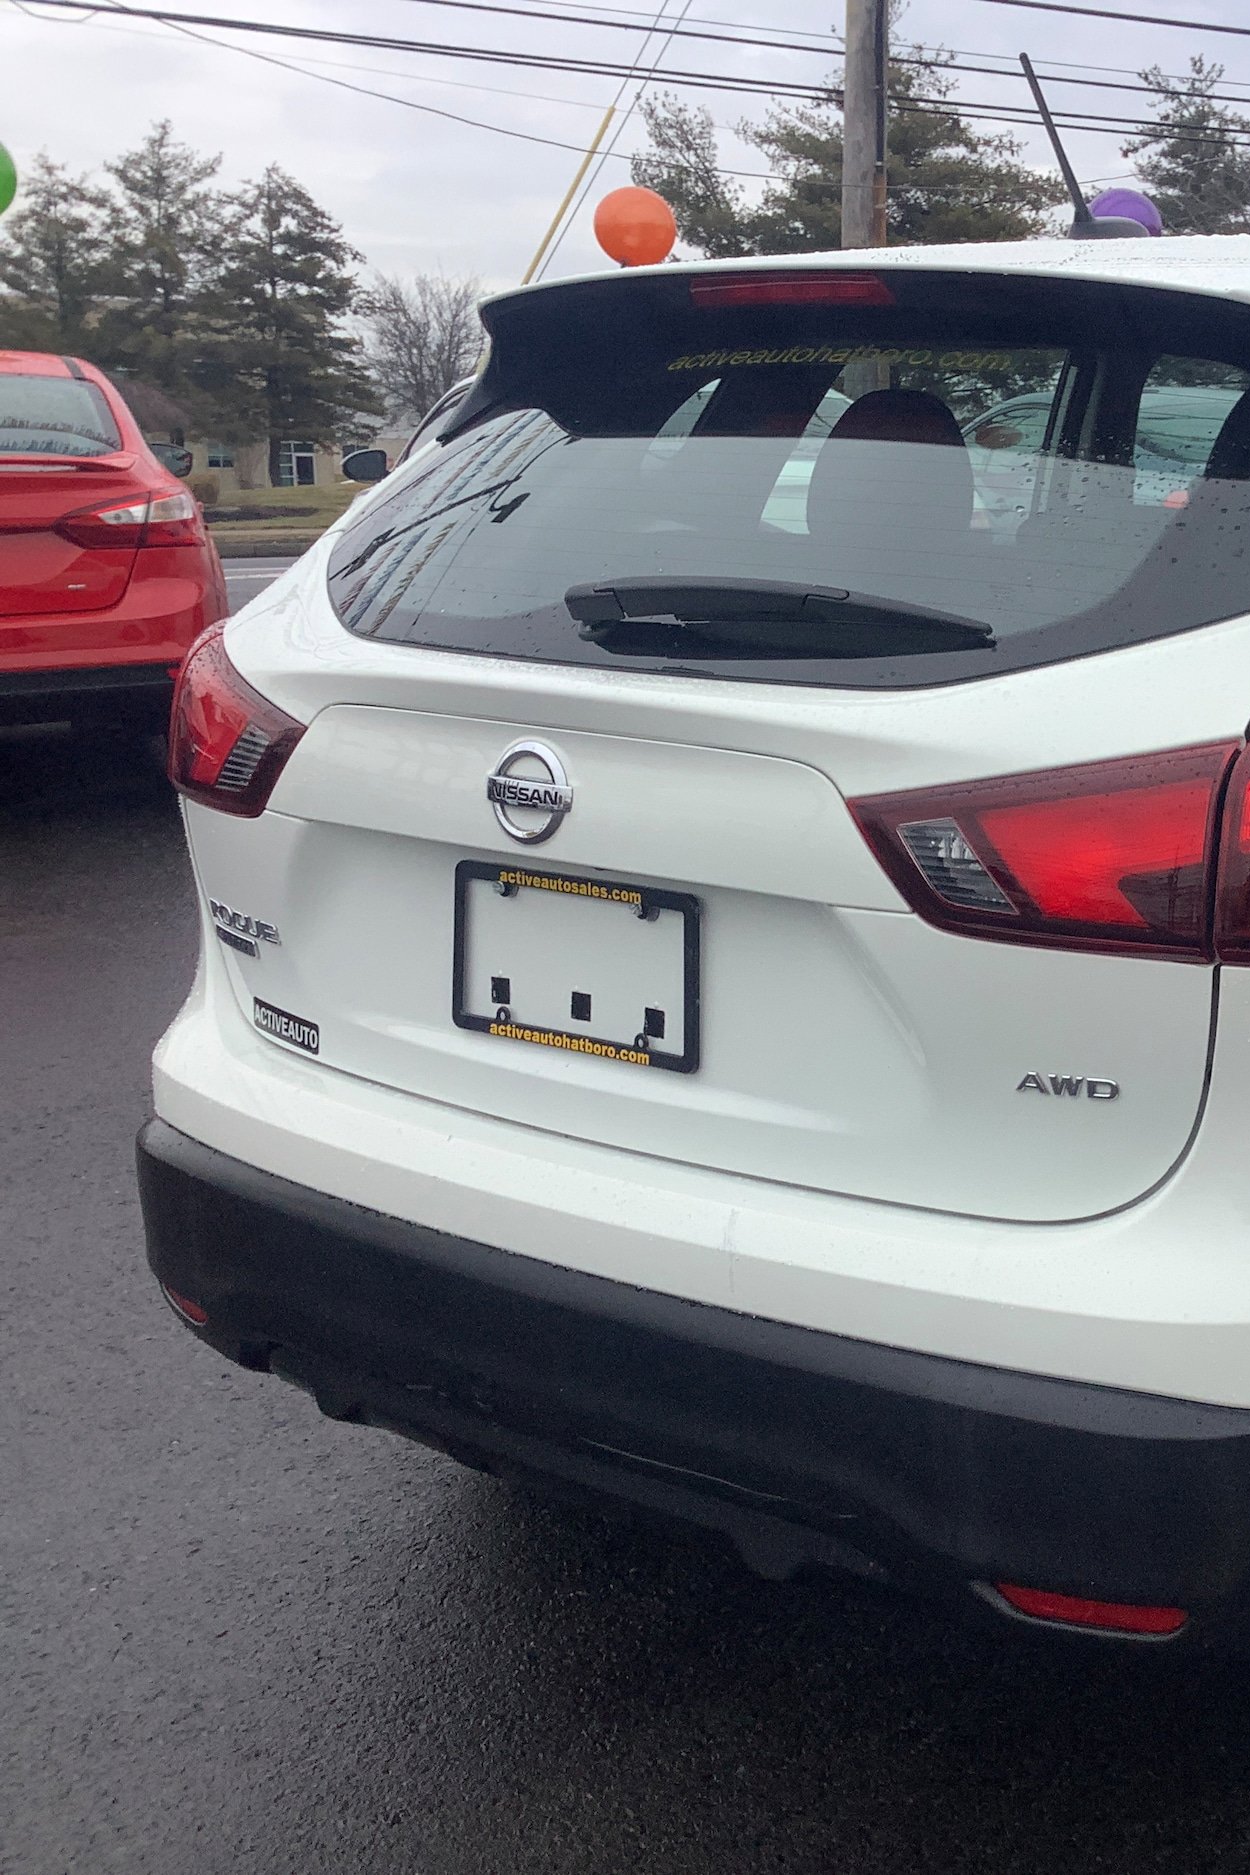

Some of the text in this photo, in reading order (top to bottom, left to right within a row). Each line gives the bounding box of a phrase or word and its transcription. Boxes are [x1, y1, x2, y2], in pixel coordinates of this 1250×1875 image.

[667, 343, 1012, 371] activeautohatboro.com
[492, 781, 560, 806] NISSAN
[500, 869, 642, 905] activeautosales.com
[254, 1003, 319, 1049] ACTIVEAUTO
[489, 1022, 650, 1066] activeautohatboro.com
[1016, 1071, 1119, 1100] AWD
